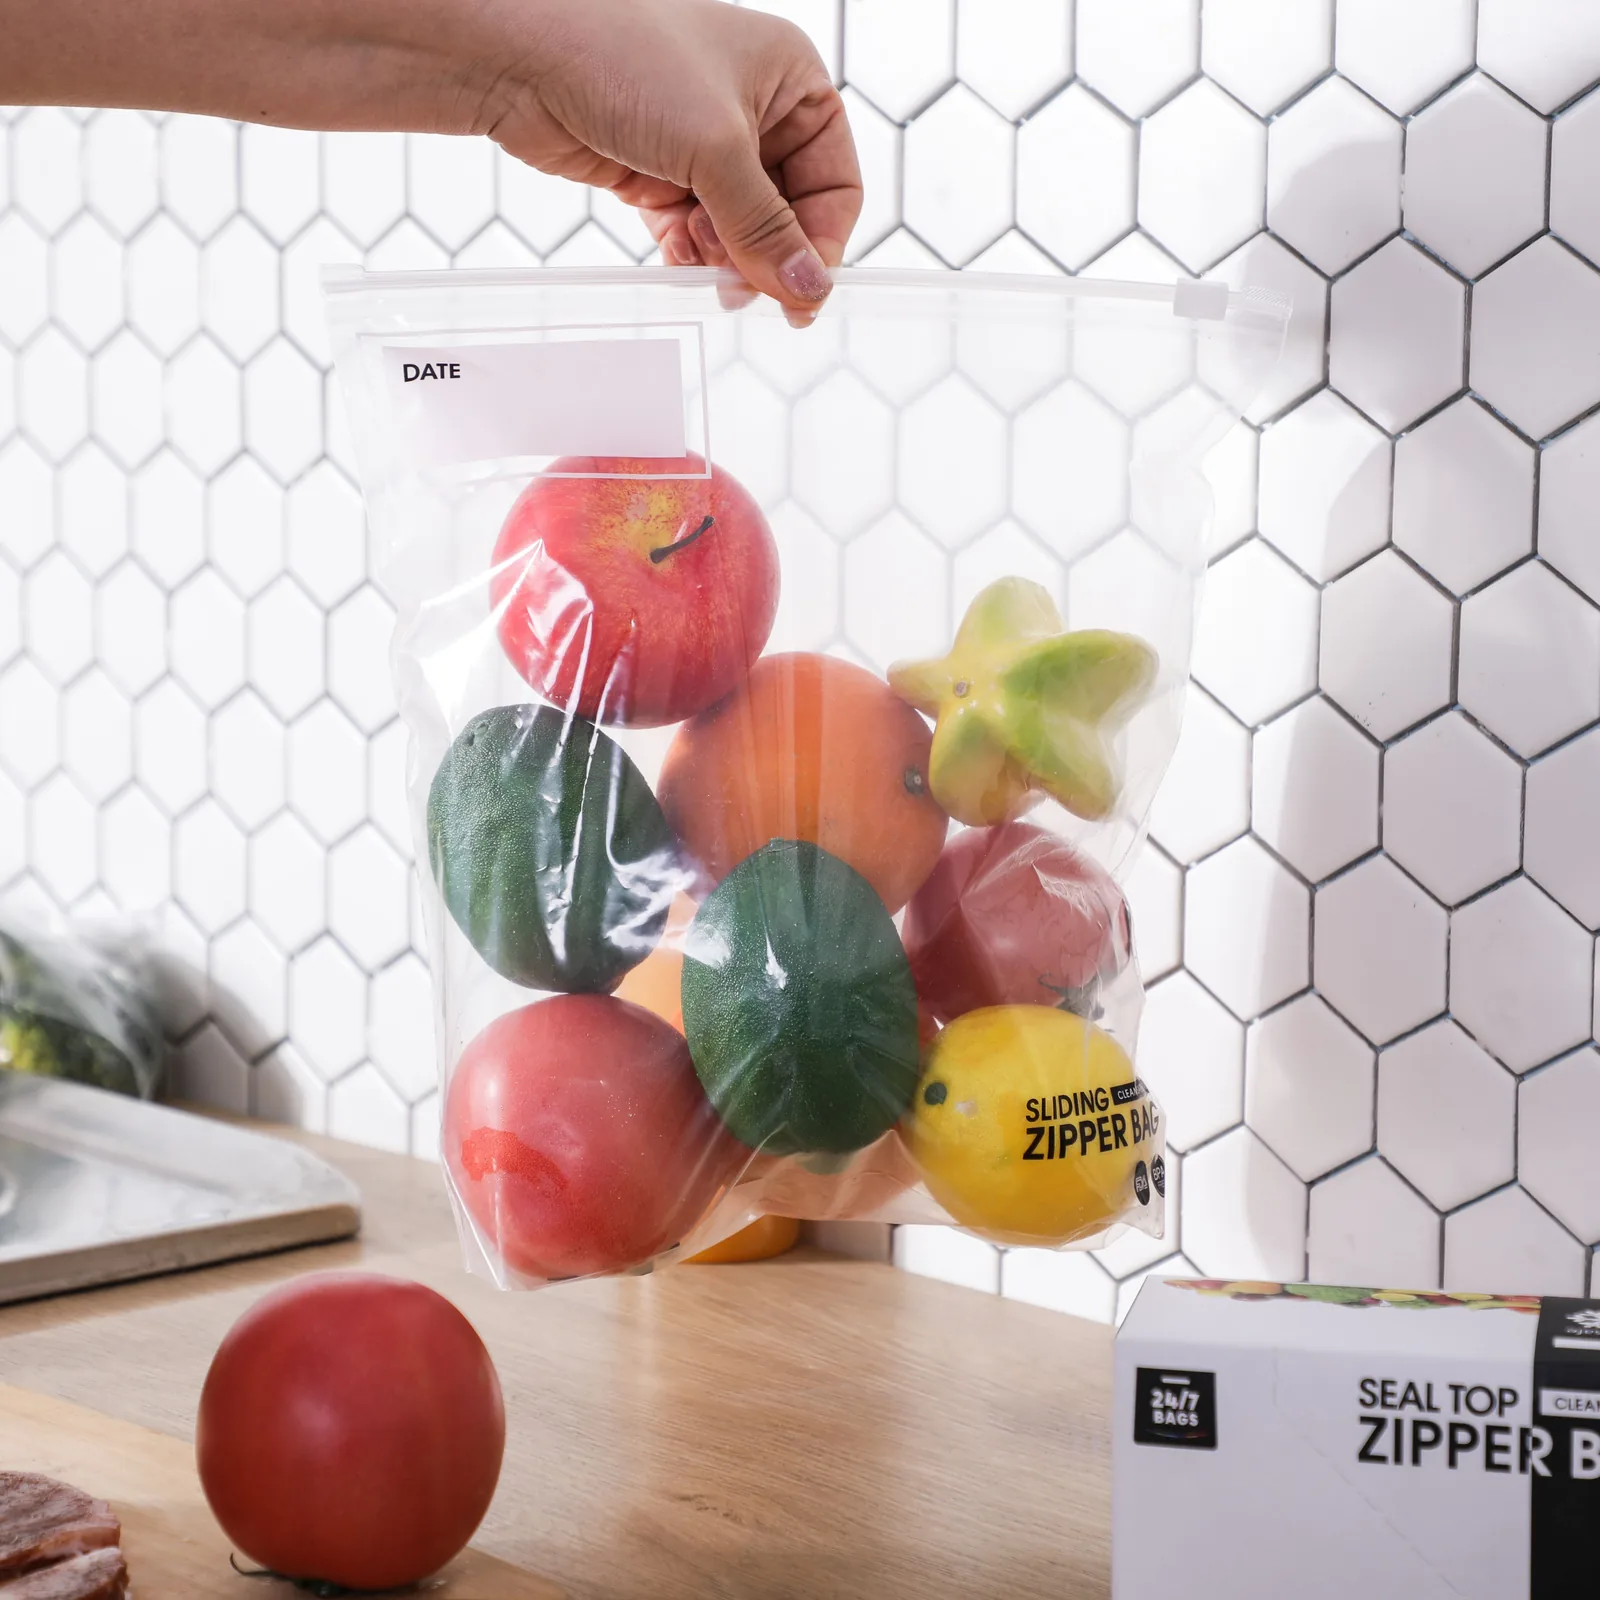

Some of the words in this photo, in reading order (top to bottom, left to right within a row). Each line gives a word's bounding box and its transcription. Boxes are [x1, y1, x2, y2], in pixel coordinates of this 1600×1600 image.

[402, 362, 461, 382] DATE
[1025, 1087, 1110, 1123] SLIDING
[1022, 1113, 1128, 1161] ZIPPER
[1130, 1100, 1160, 1144] BAG
[1150, 1387, 1200, 1412] 24/7
[1358, 1377, 1442, 1414] SEAL
[1447, 1383, 1520, 1418] TOP
[1152, 1409, 1200, 1428] BAGS
[1357, 1415, 1554, 1478] ZIPPER
